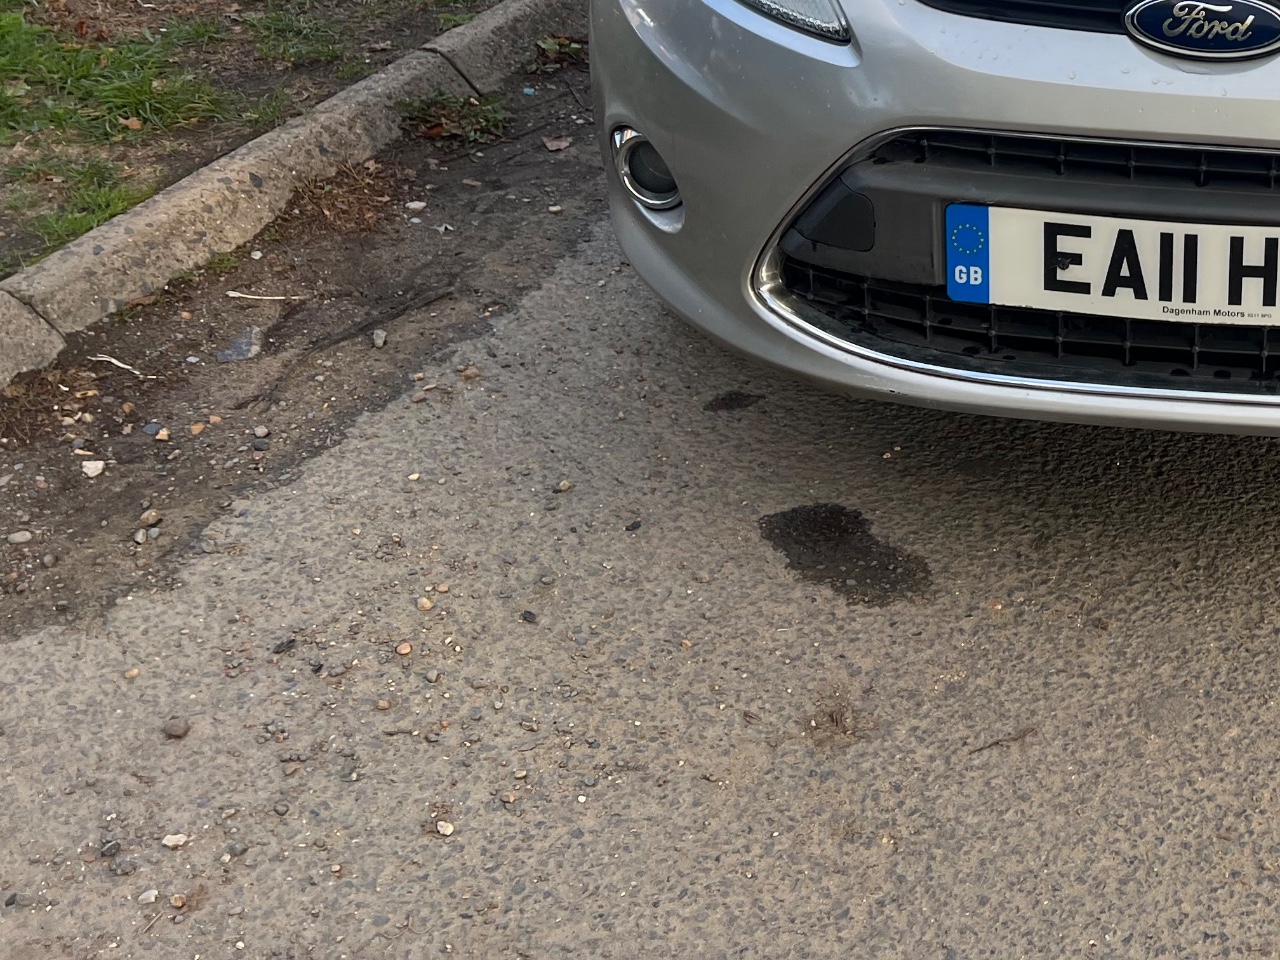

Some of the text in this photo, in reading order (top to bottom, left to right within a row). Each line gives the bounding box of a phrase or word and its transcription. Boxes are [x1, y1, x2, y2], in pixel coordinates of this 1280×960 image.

[1162, 1, 1255, 41] Ford
[953, 265, 983, 286] GB
[1043, 222, 1199, 304] EA11
[1162, 306, 1211, 317] Dagenham
[1213, 309, 1245, 318] Motors
